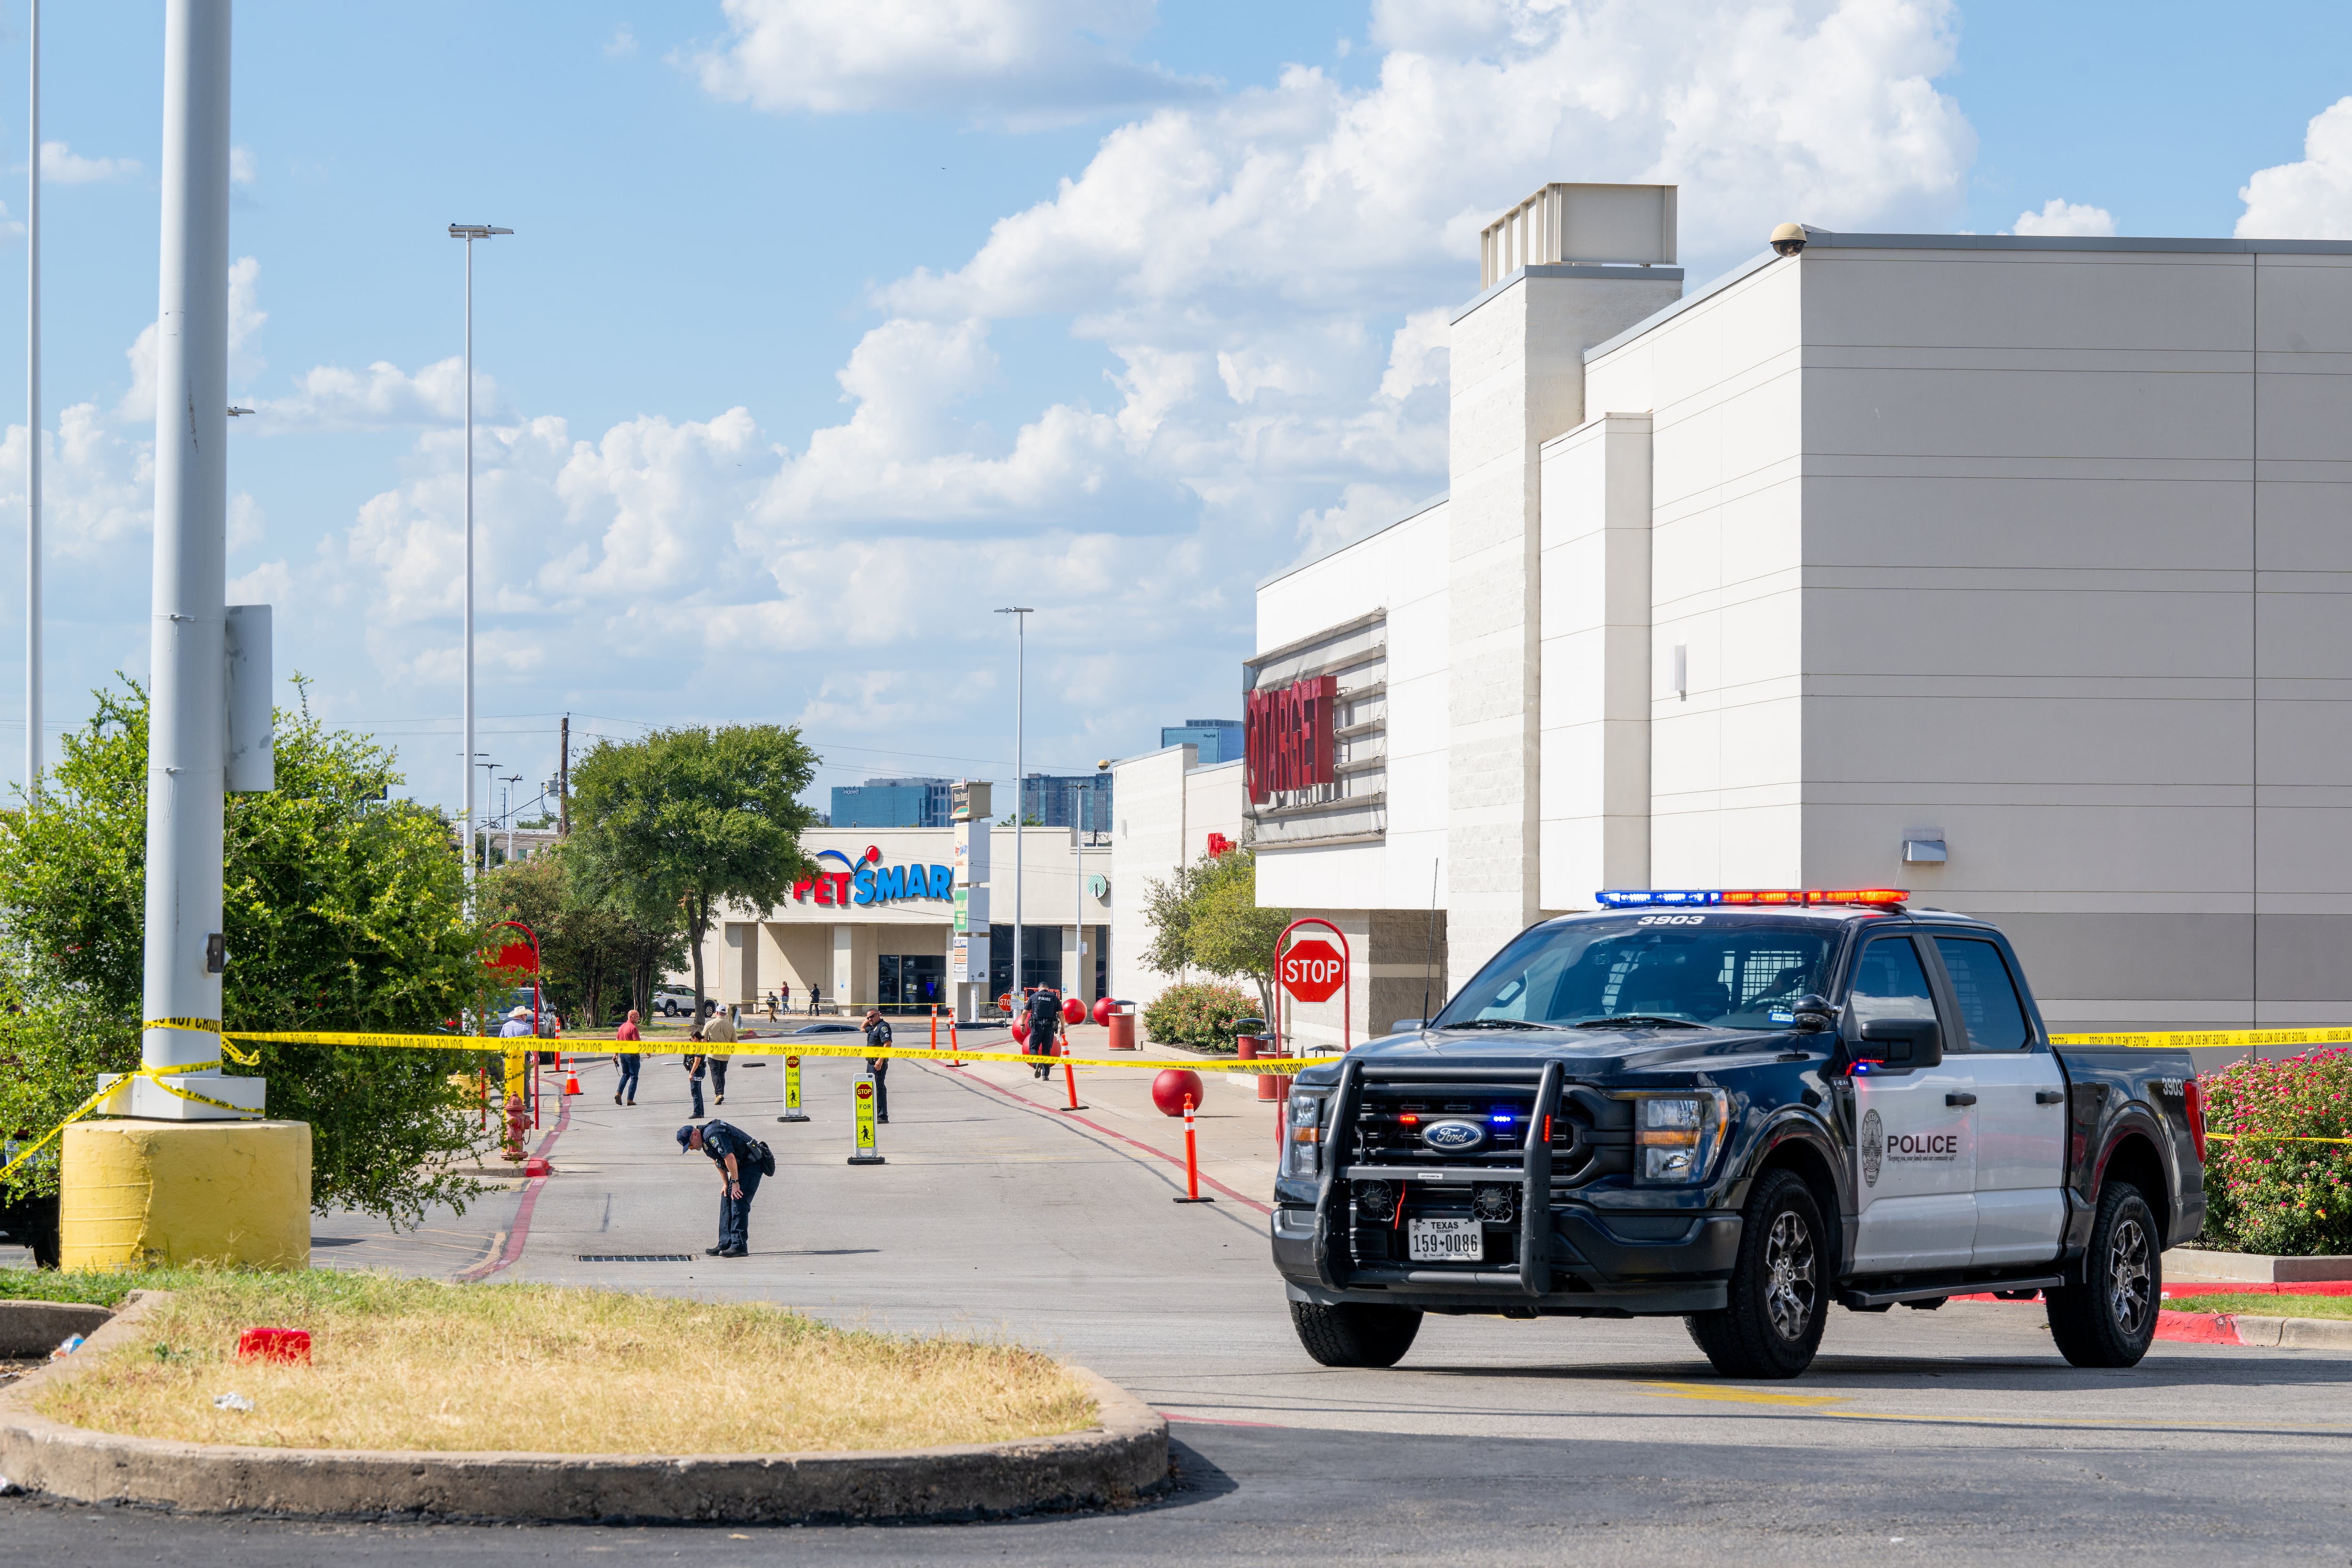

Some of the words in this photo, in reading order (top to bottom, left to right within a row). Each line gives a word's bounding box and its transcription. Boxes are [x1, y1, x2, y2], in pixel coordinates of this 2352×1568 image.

[1260, 676, 1334, 792] TARGET
[793, 864, 954, 905] PETSMAR
[1637, 916, 1705, 925] 3903
[1285, 959, 1340, 983] STOP
[2170, 1035, 2184, 1046] CROSS
[2185, 1035, 2193, 1045] NOT
[2195, 1035, 2201, 1045] DO
[2202, 1035, 2212, 1045] LINE
[2213, 1034, 2228, 1045] POLICE
[2249, 1033, 2263, 1043] CROSS
[2264, 1033, 2273, 1043] NOT
[2274, 1033, 2280, 1043] DO
[2281, 1032, 2291, 1042] LINE
[2292, 1031, 2307, 1042] POLICE
[2327, 1031, 2341, 1040] CROSS
[2134, 1036, 2149, 1047] POLICE
[1262, 1064, 1273, 1074] DO
[1272, 1064, 1287, 1074] LINE
[2162, 1078, 2183, 1096] 3903
[1437, 1128, 1467, 1142] Ford
[1887, 1135, 1957, 1153] POLICE
